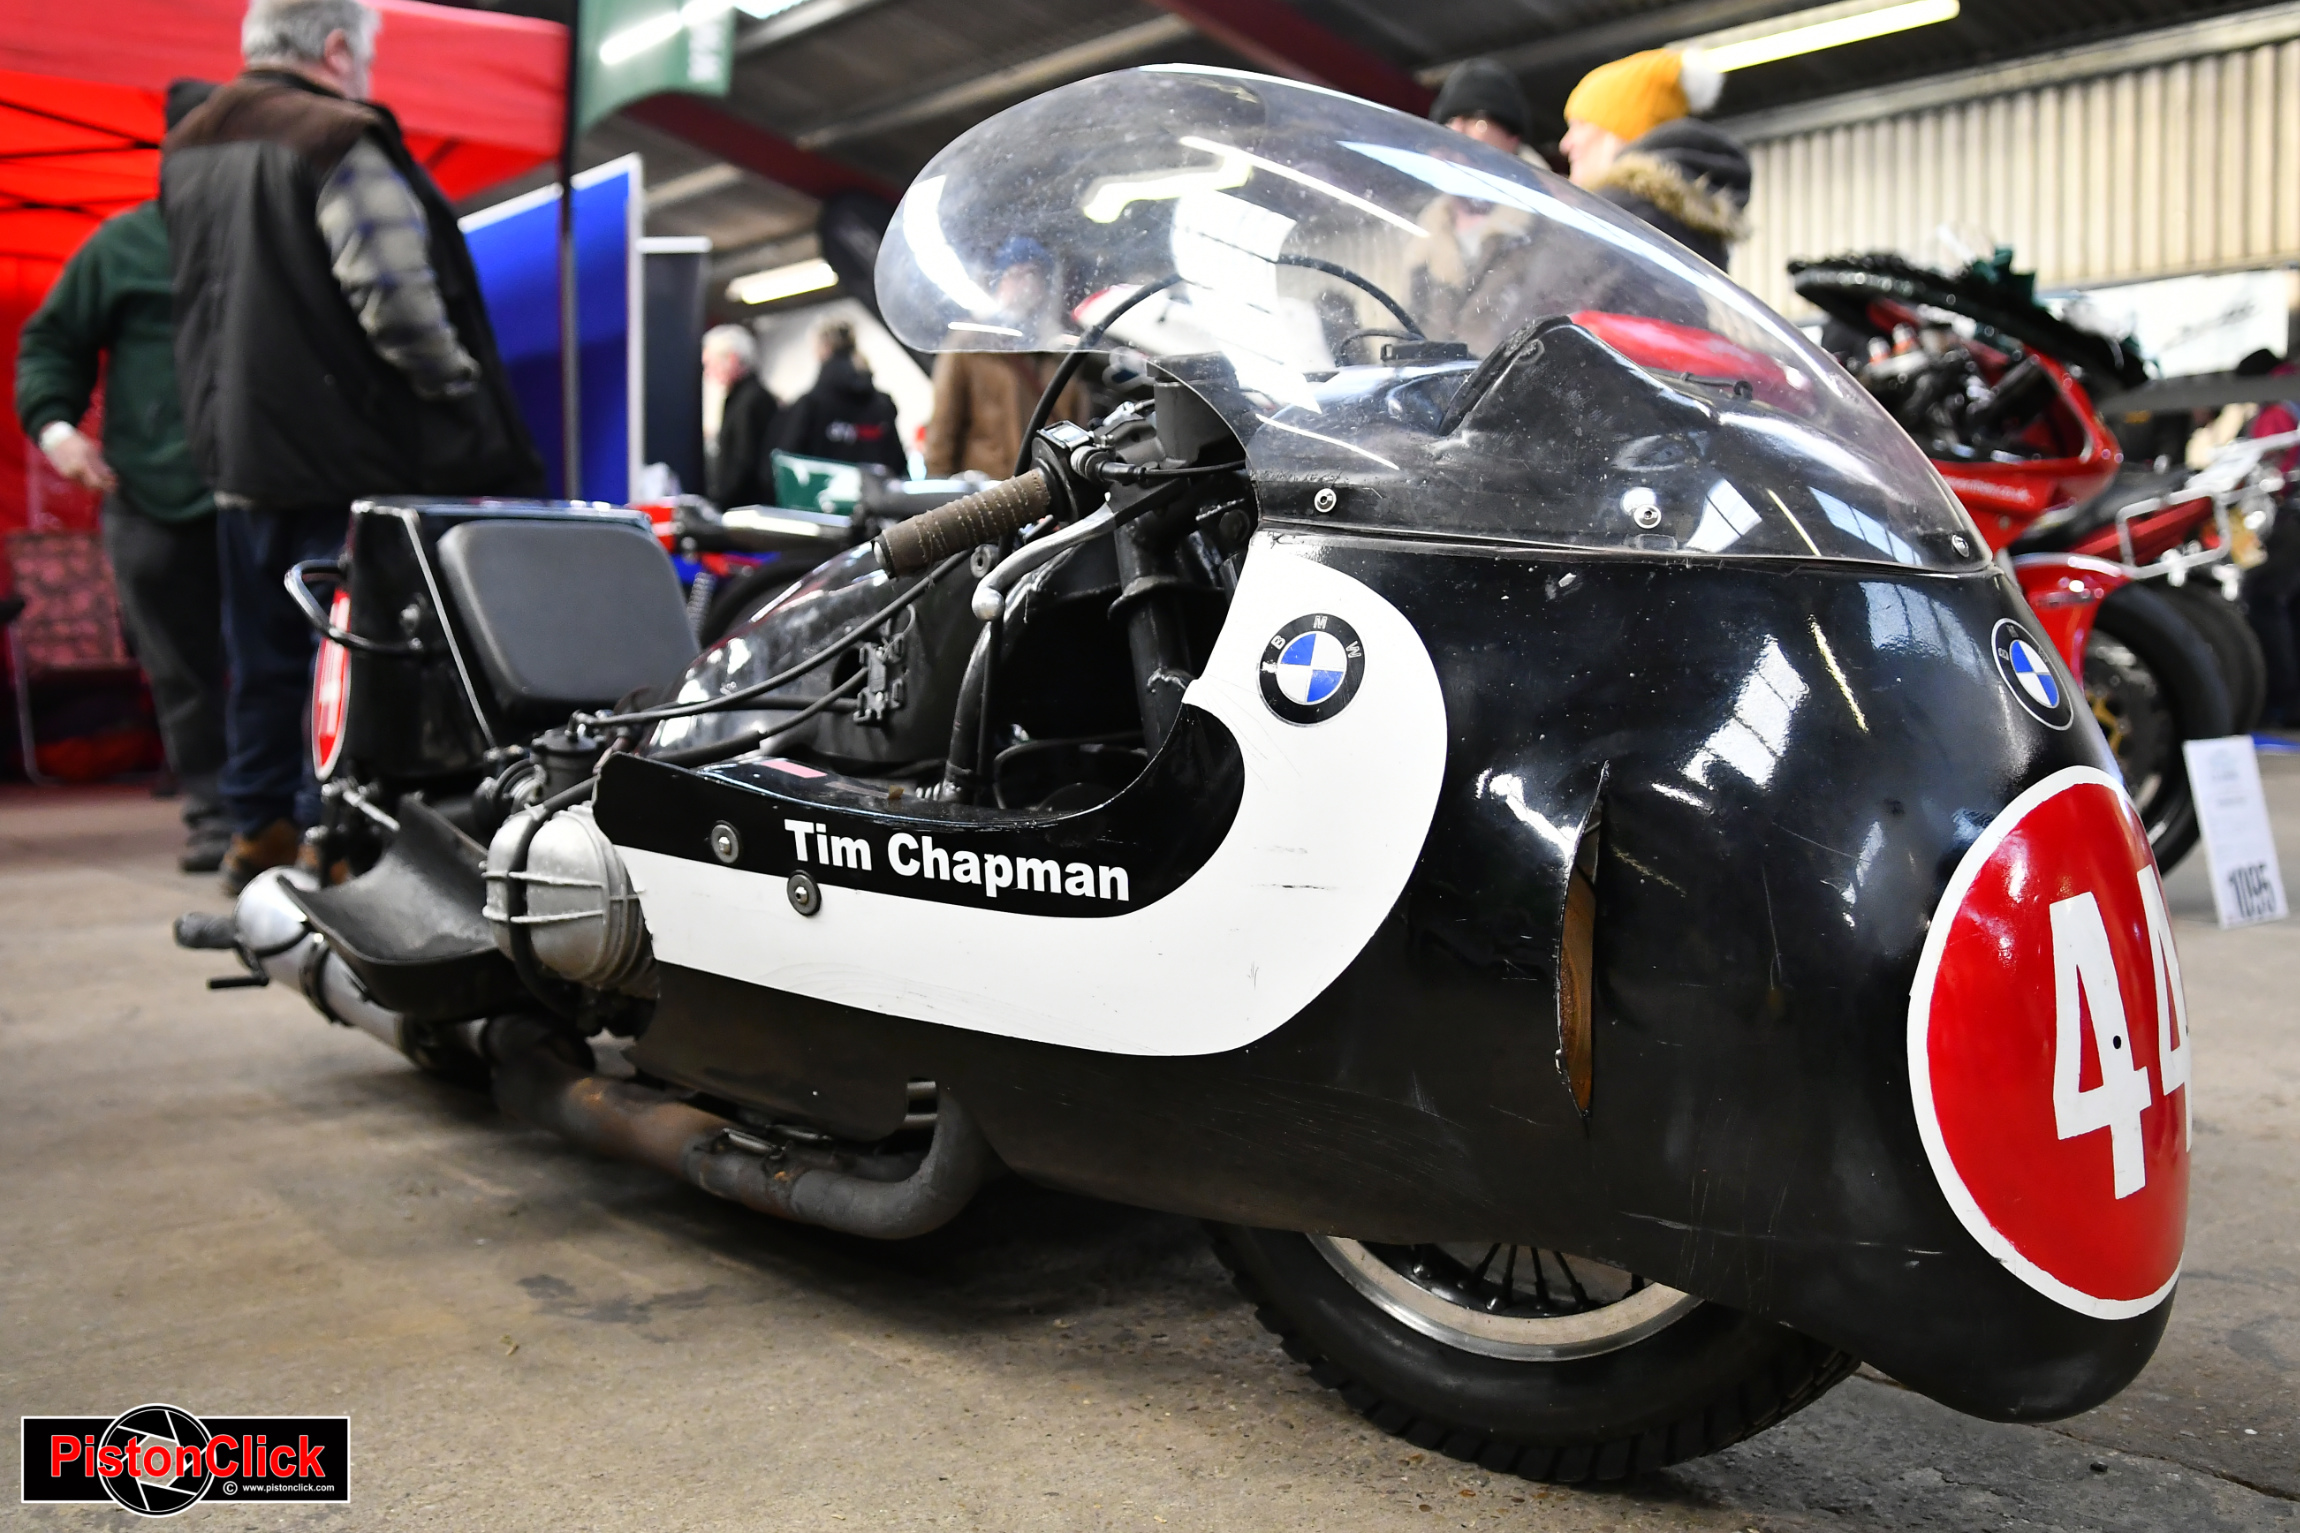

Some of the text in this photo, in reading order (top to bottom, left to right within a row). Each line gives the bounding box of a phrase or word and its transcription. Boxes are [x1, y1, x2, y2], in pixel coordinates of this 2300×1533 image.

[1270, 615, 1362, 659] BMW
[784, 819, 1130, 901] Tim Chapman
[2049, 863, 2193, 1200] 44
